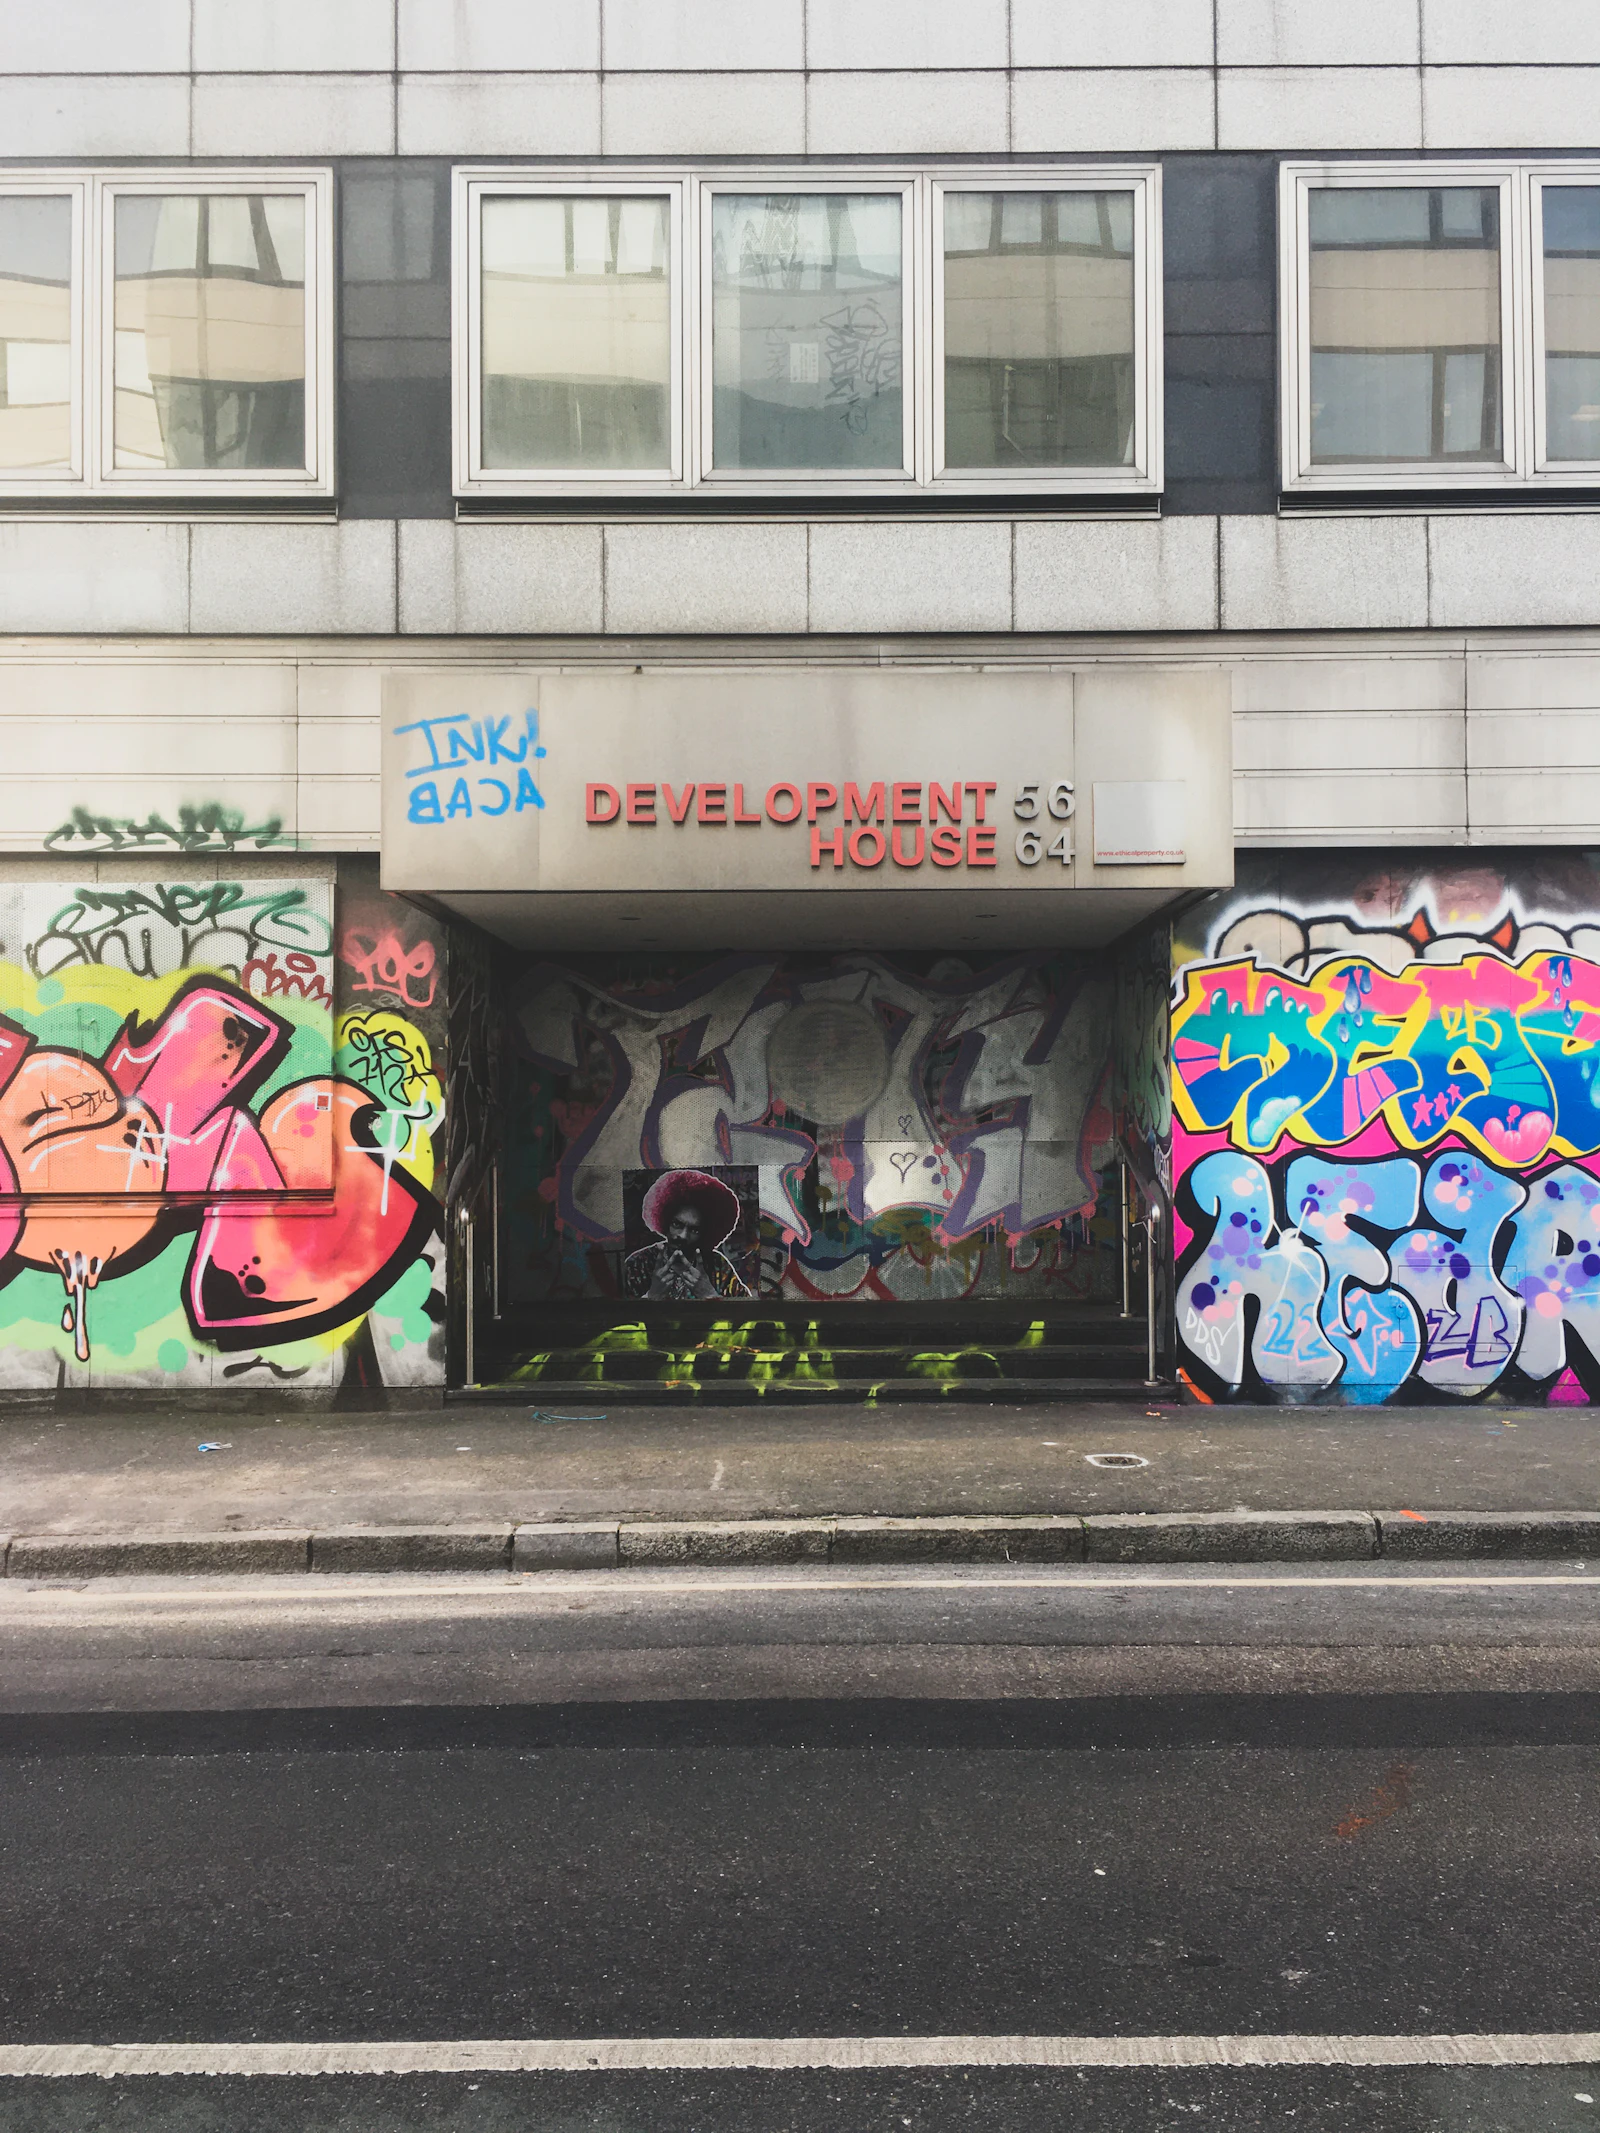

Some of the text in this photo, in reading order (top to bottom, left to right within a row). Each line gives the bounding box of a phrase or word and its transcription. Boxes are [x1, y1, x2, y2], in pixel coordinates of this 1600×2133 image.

[585, 779, 1077, 826] DEVELOPMENT 56
[810, 826, 1077, 868] HOUSE 64
[1096, 849, 1185, 857] www.ethicalproperty.co.uk
